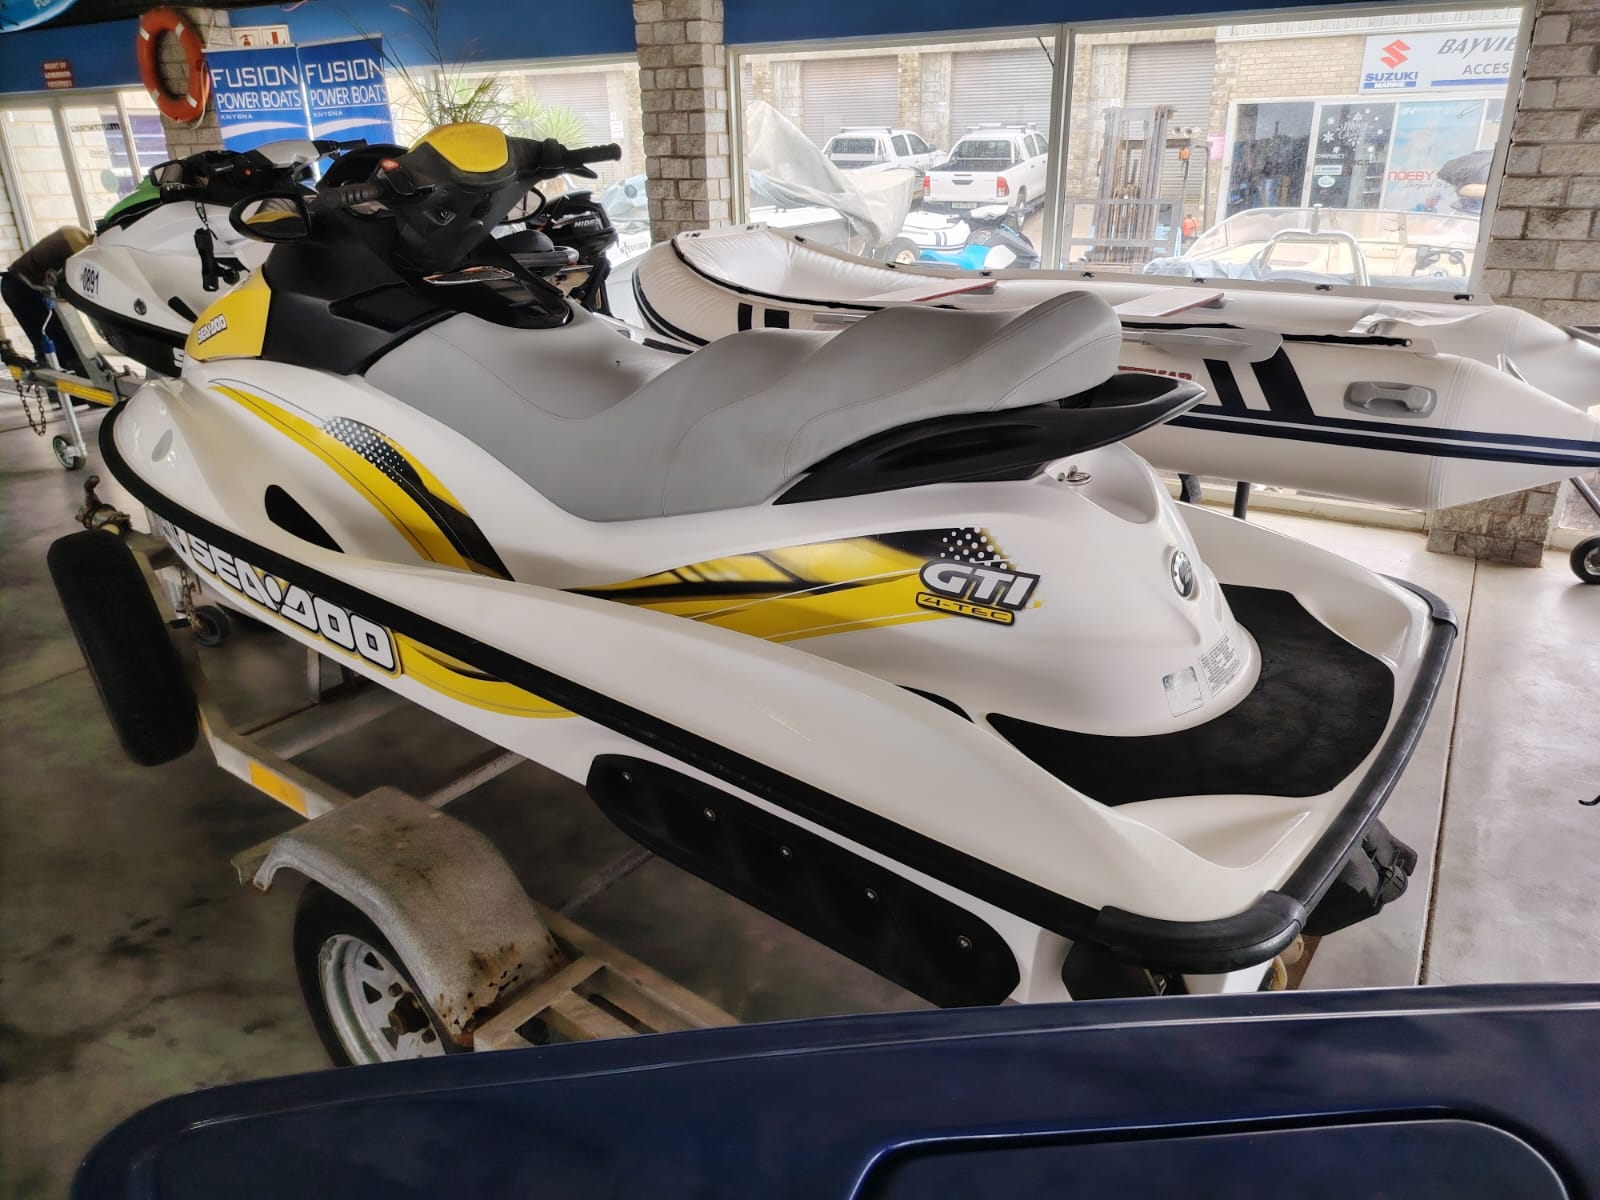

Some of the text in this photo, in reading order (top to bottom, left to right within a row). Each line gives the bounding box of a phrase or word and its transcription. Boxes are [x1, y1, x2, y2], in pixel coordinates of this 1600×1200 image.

[210, 65, 298, 88] FUSION
[305, 57, 385, 85] FUSION
[1365, 71, 1418, 81] SUZUKI
[1462, 63, 1509, 75] ACCES
[216, 89, 302, 109] POWER BOATS
[310, 84, 387, 107] POWER BOATS
[313, 110, 344, 118] KNYSNA
[921, 561, 1037, 608] GTI
[921, 596, 1010, 622] 4-TEC
